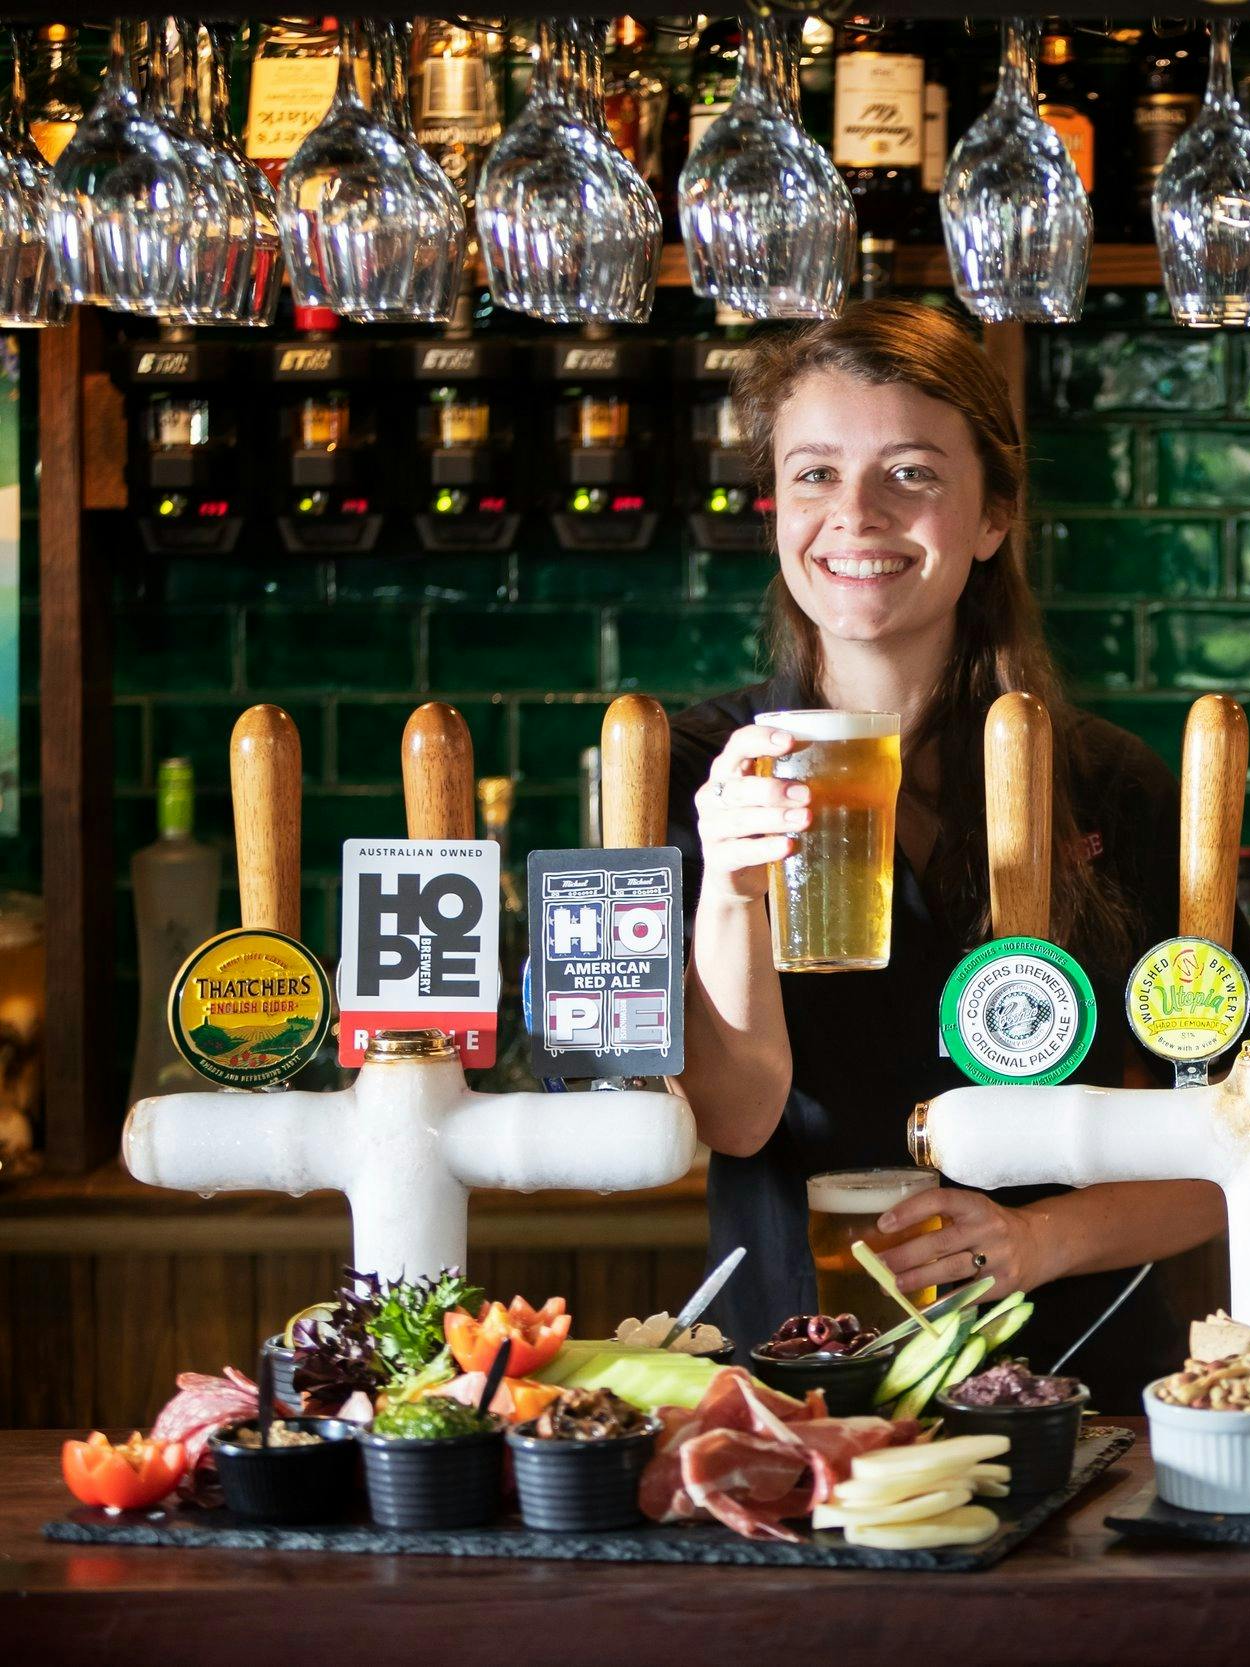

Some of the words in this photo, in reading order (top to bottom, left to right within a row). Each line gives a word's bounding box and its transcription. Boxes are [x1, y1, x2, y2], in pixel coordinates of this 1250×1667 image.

[359, 848, 433, 857] AUSTRALIAN
[440, 849, 483, 857] OWNED
[420, 937, 432, 994] BREWERY
[564, 961, 650, 976] AMERICAN
[964, 947, 997, 975] ADDITIVES
[1003, 942, 1016, 951] NO
[1016, 942, 1068, 967] PRESERVATIVES
[196, 975, 311, 999] THATCHERS
[574, 976, 605, 989] RED
[611, 976, 641, 988] ALE
[967, 965, 1011, 1019] COOPERS
[1015, 964, 1069, 1005] BREWERY
[1139, 958, 1169, 1023] WOOLSHED
[1209, 958, 1238, 1022] BREWERY
[210, 1002, 257, 1015] ENGLISH
[263, 1001, 294, 1014] CIDER
[1153, 985, 1225, 1015] Utopia
[1155, 1021, 1177, 1029] HARD
[1180, 1020, 1219, 1028] LEMONADE
[972, 1032, 1027, 1068] ORIGINAL
[1029, 1041, 1060, 1066] PALE
[1057, 1016, 1071, 1042] ALE
[1158, 1036, 1174, 1049] Brew
[1177, 1044, 1192, 1052] with
[1202, 1037, 1218, 1048] view
[225, 1071, 239, 1081] AND
[241, 1068, 282, 1082] REFRESHING
